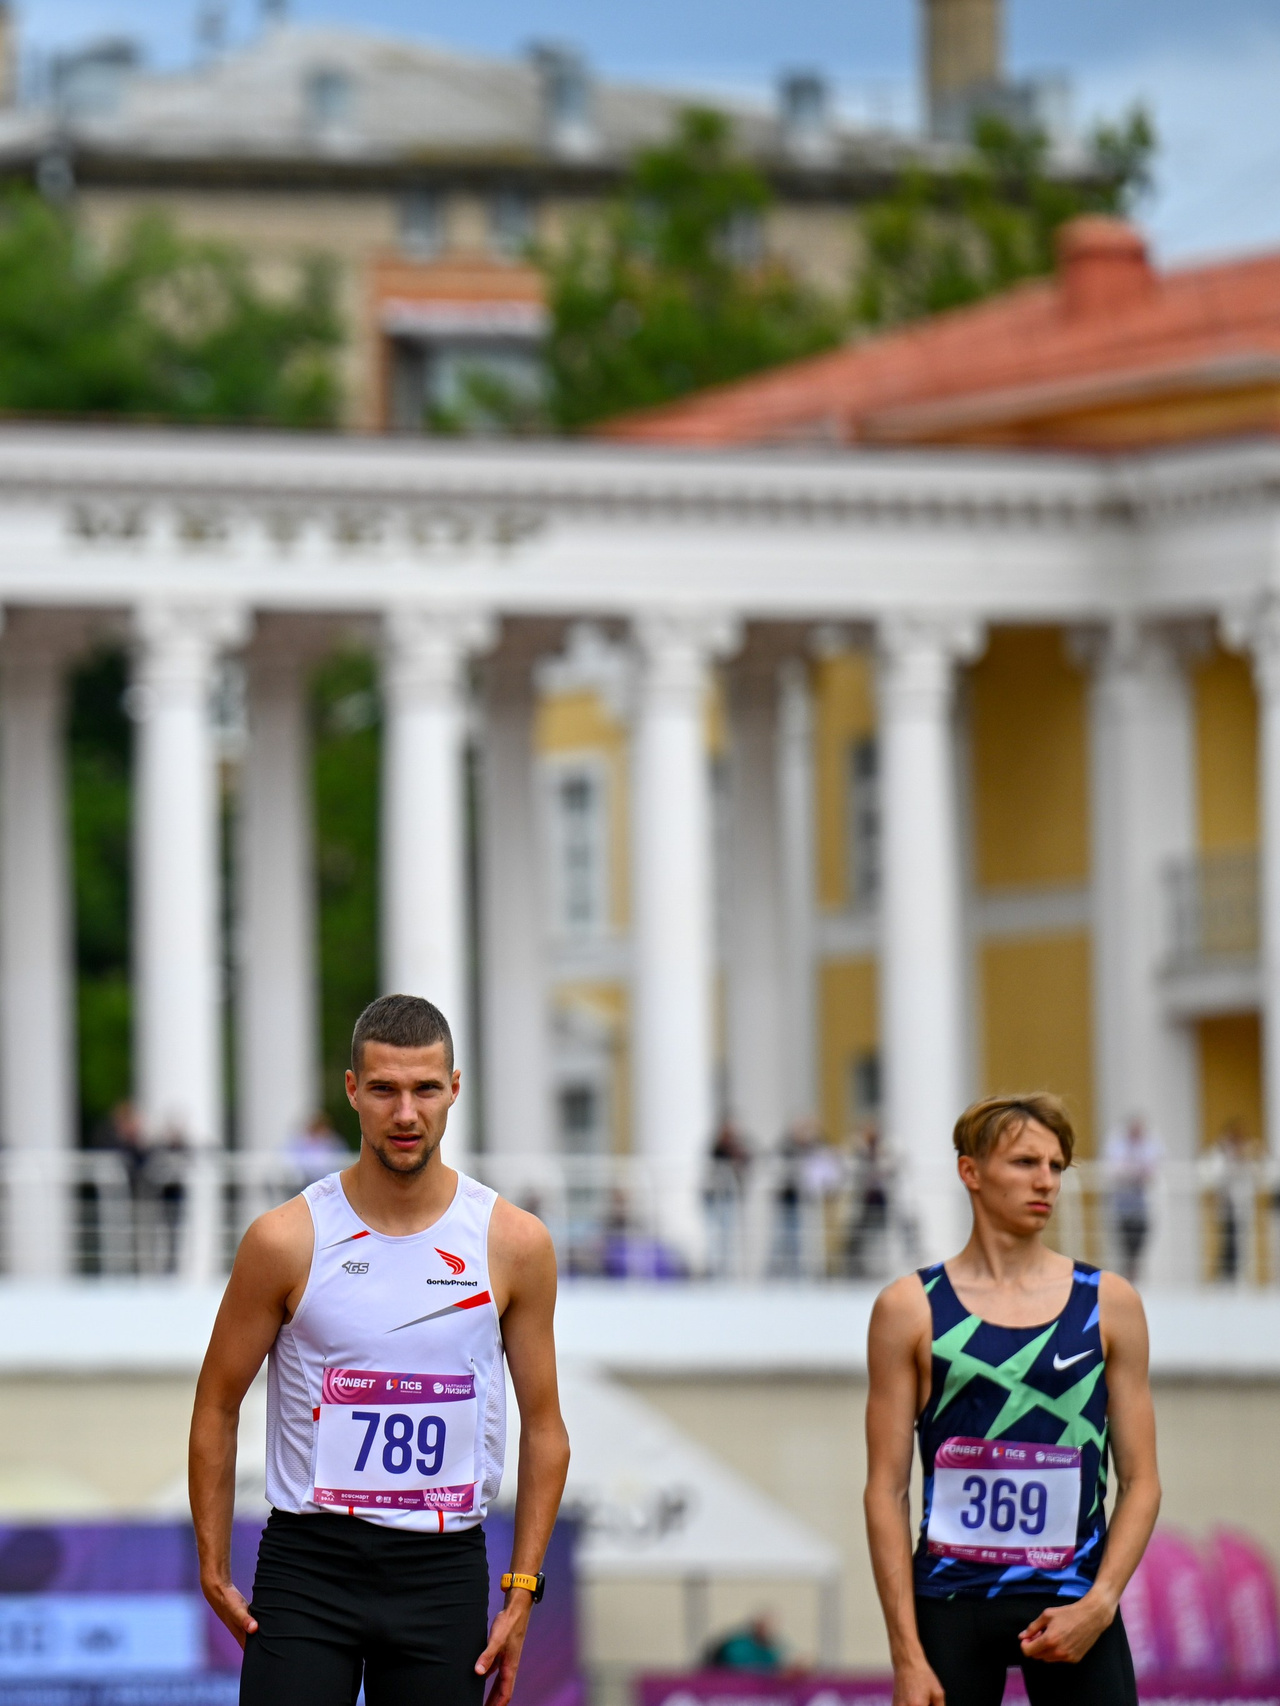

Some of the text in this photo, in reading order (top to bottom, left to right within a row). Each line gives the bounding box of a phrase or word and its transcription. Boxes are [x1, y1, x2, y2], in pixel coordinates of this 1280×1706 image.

[331, 1376, 376, 1389] FONBET
[400, 1381, 422, 1391] ПСБ
[352, 1411, 447, 1476] 789
[942, 1444, 984, 1456] FONBET
[1005, 1449, 1026, 1458] ПСБ
[424, 1493, 465, 1502] FONBET
[960, 1475, 1048, 1535] 369
[1027, 1550, 1066, 1562] FONBET
